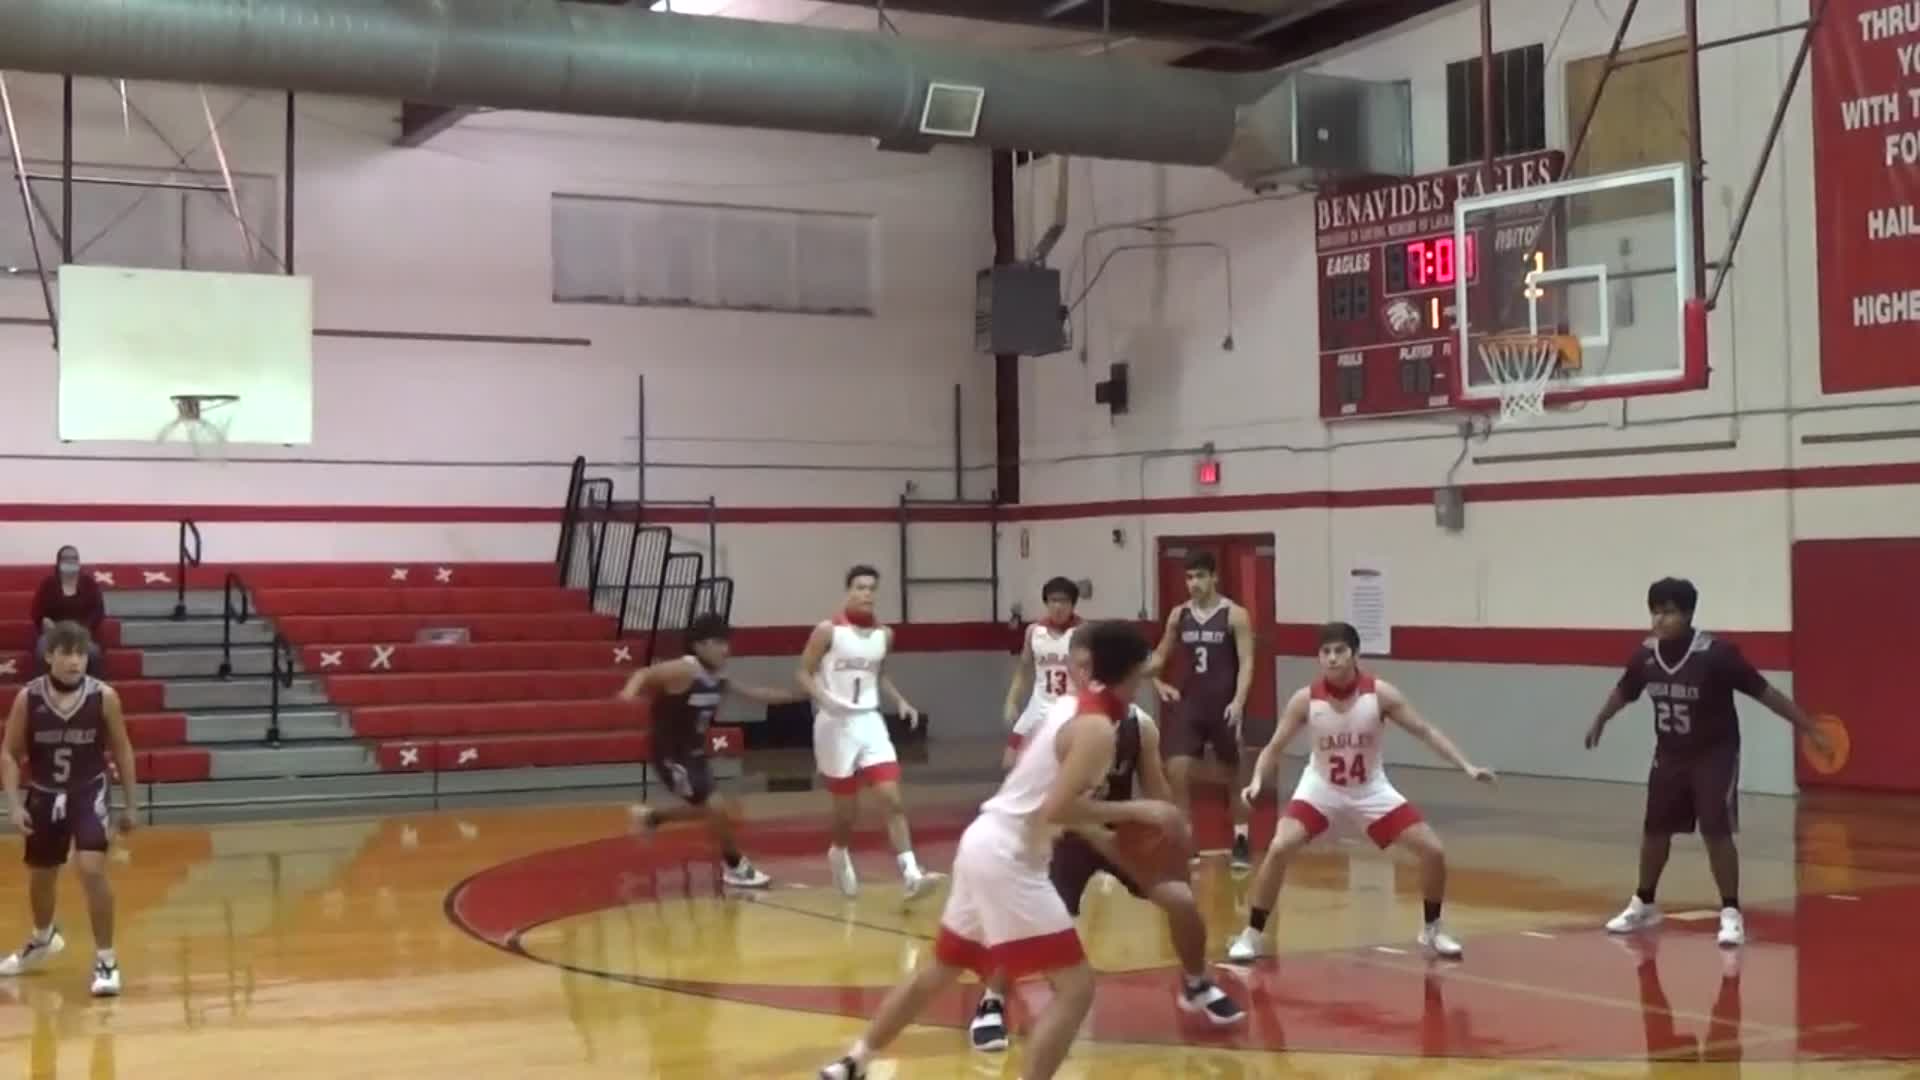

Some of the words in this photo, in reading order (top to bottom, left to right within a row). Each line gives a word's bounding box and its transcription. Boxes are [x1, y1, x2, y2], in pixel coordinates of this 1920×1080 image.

[1841, 92, 1900, 131] WITH
[1885, 130, 1920, 167] FO
[1317, 176, 1445, 231] BENAVIDES
[1867, 204, 1920, 241] HAIL
[1326, 252, 1371, 277] EAGLES
[1431, 297, 1440, 330] 1
[1853, 288, 1920, 327] HIGHE
[1195, 646, 1208, 673] 3
[851, 676, 861, 705] 1
[1045, 669, 1068, 696] 13
[1657, 701, 1691, 735] 25
[52, 747, 73, 782] 5
[1329, 753, 1368, 787] 24
